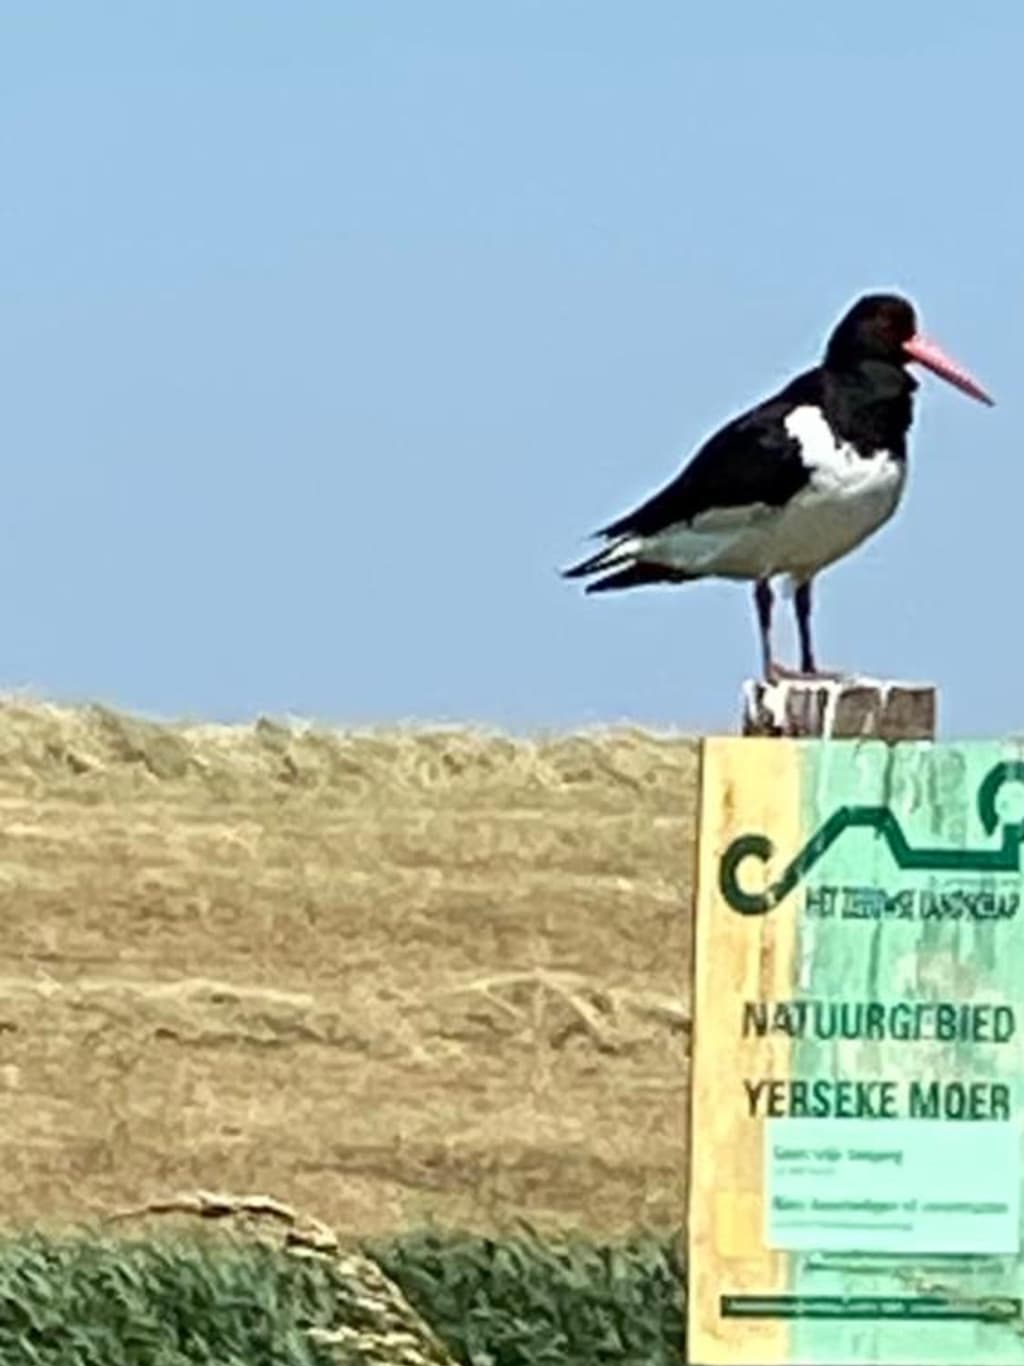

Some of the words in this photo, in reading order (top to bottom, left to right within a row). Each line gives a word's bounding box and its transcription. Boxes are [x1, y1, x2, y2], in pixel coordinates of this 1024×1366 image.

[742, 1001, 1015, 1043] NATUURGEBIED
[743, 1079, 898, 1118] YERSEKE
[908, 1081, 1010, 1120] MOER
